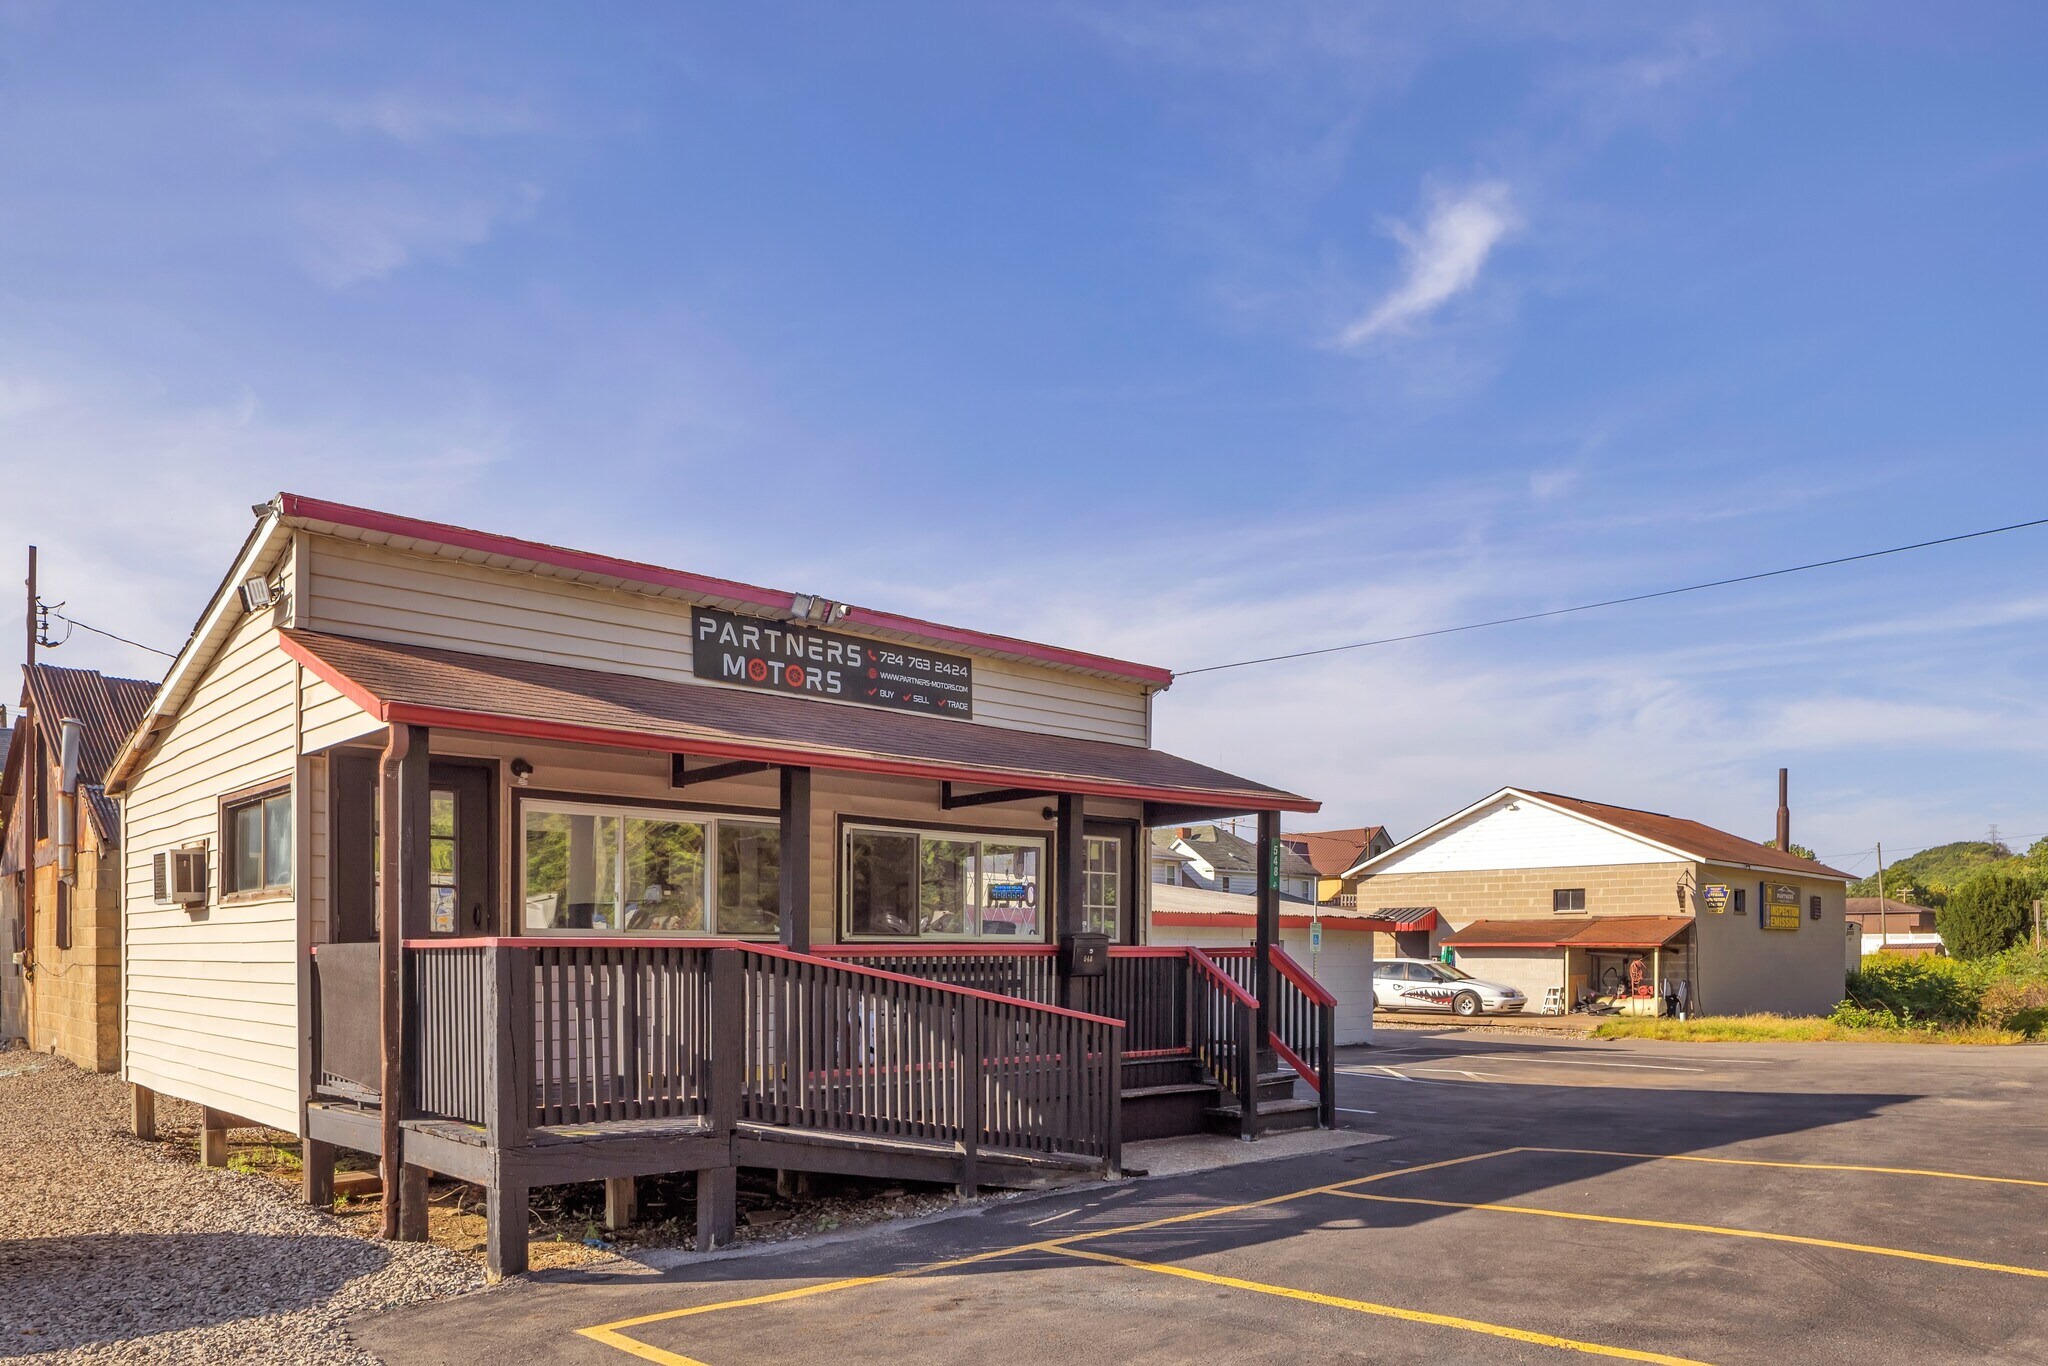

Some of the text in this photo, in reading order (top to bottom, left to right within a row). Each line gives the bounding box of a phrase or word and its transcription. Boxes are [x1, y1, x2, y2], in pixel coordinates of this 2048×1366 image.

[699, 617, 862, 668] PARTNERS
[723, 653, 841, 694] MOTORS
[879, 651, 968, 678] 724 763 2424
[880, 671, 969, 693] WWW.PARTNERS-MOTORS.COM
[879, 689, 969, 711] BUY SELL TRADE
[1770, 905, 1800, 917] INSPECTION
[1770, 917, 1799, 928] EMISSION
